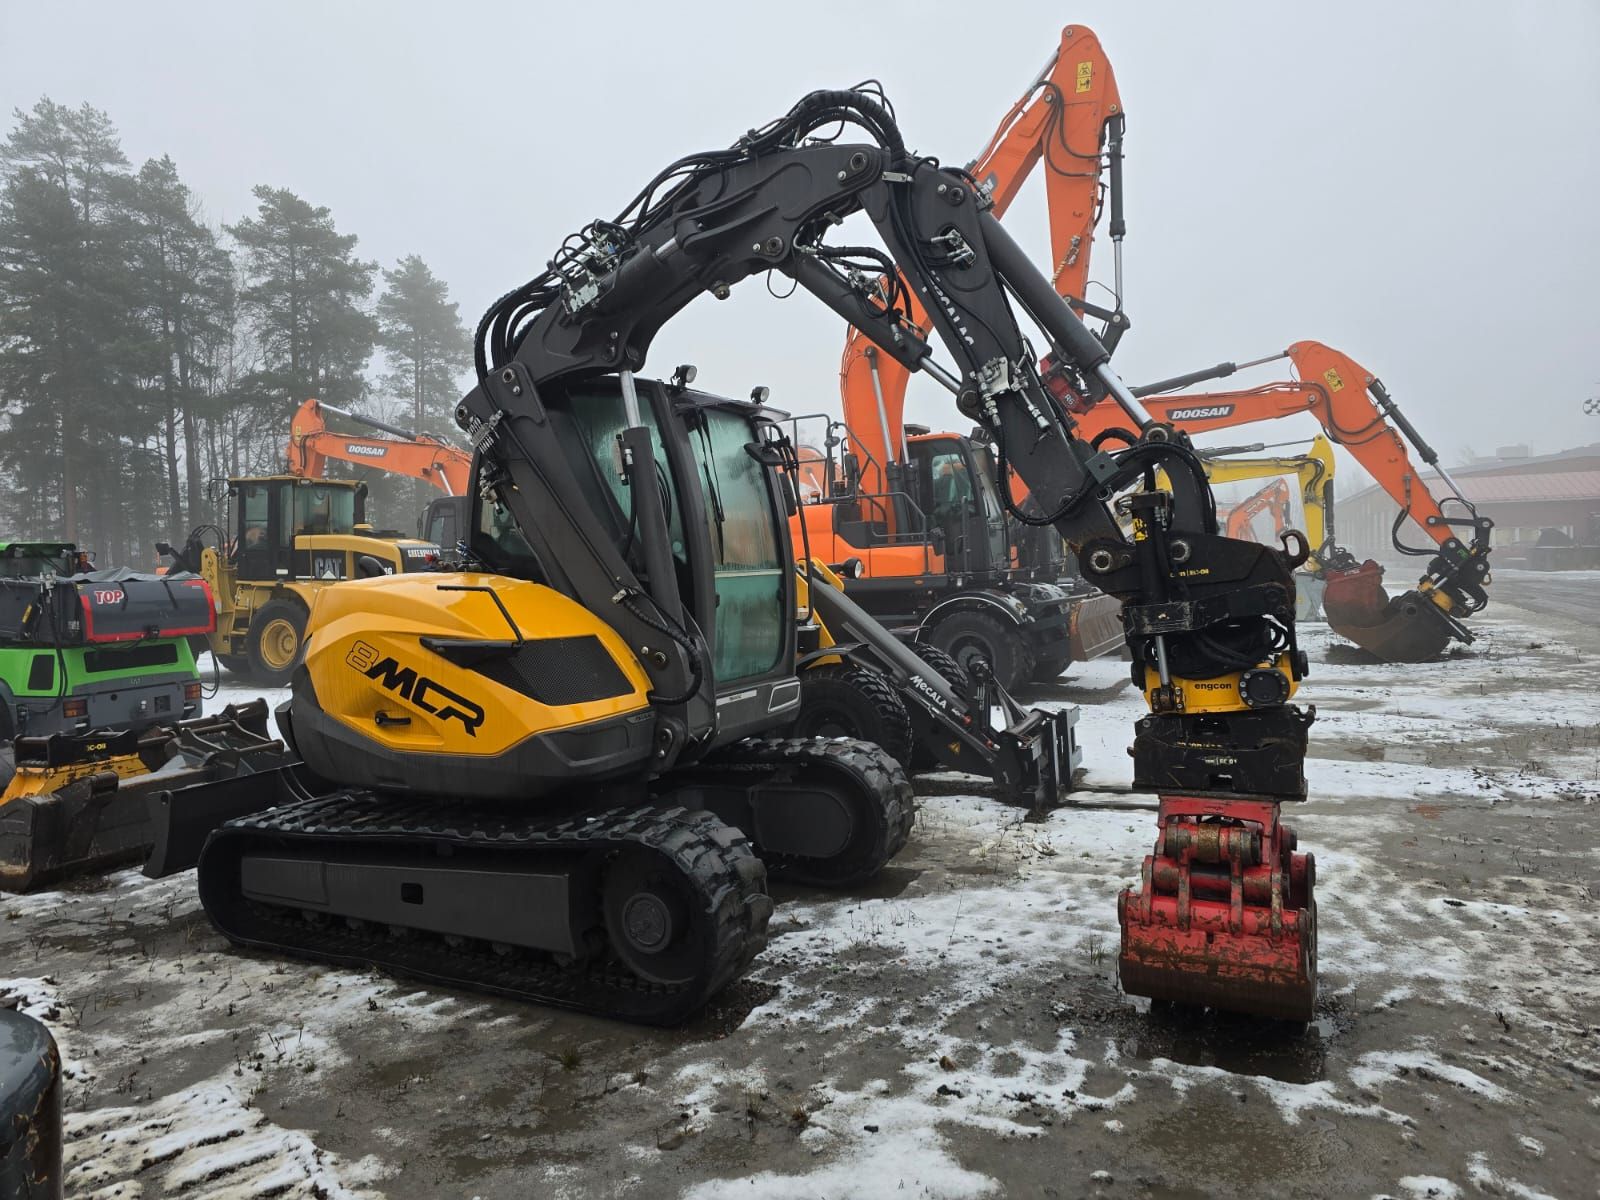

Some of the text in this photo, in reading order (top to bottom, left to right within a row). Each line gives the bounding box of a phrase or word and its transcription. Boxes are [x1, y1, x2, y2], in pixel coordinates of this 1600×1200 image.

[1171, 406, 1230, 419] DOOSAN
[348, 445, 385, 456] DOOSAN
[314, 557, 342, 579] CAT
[94, 590, 124, 604] TOP
[1194, 683, 1232, 691] engcon
